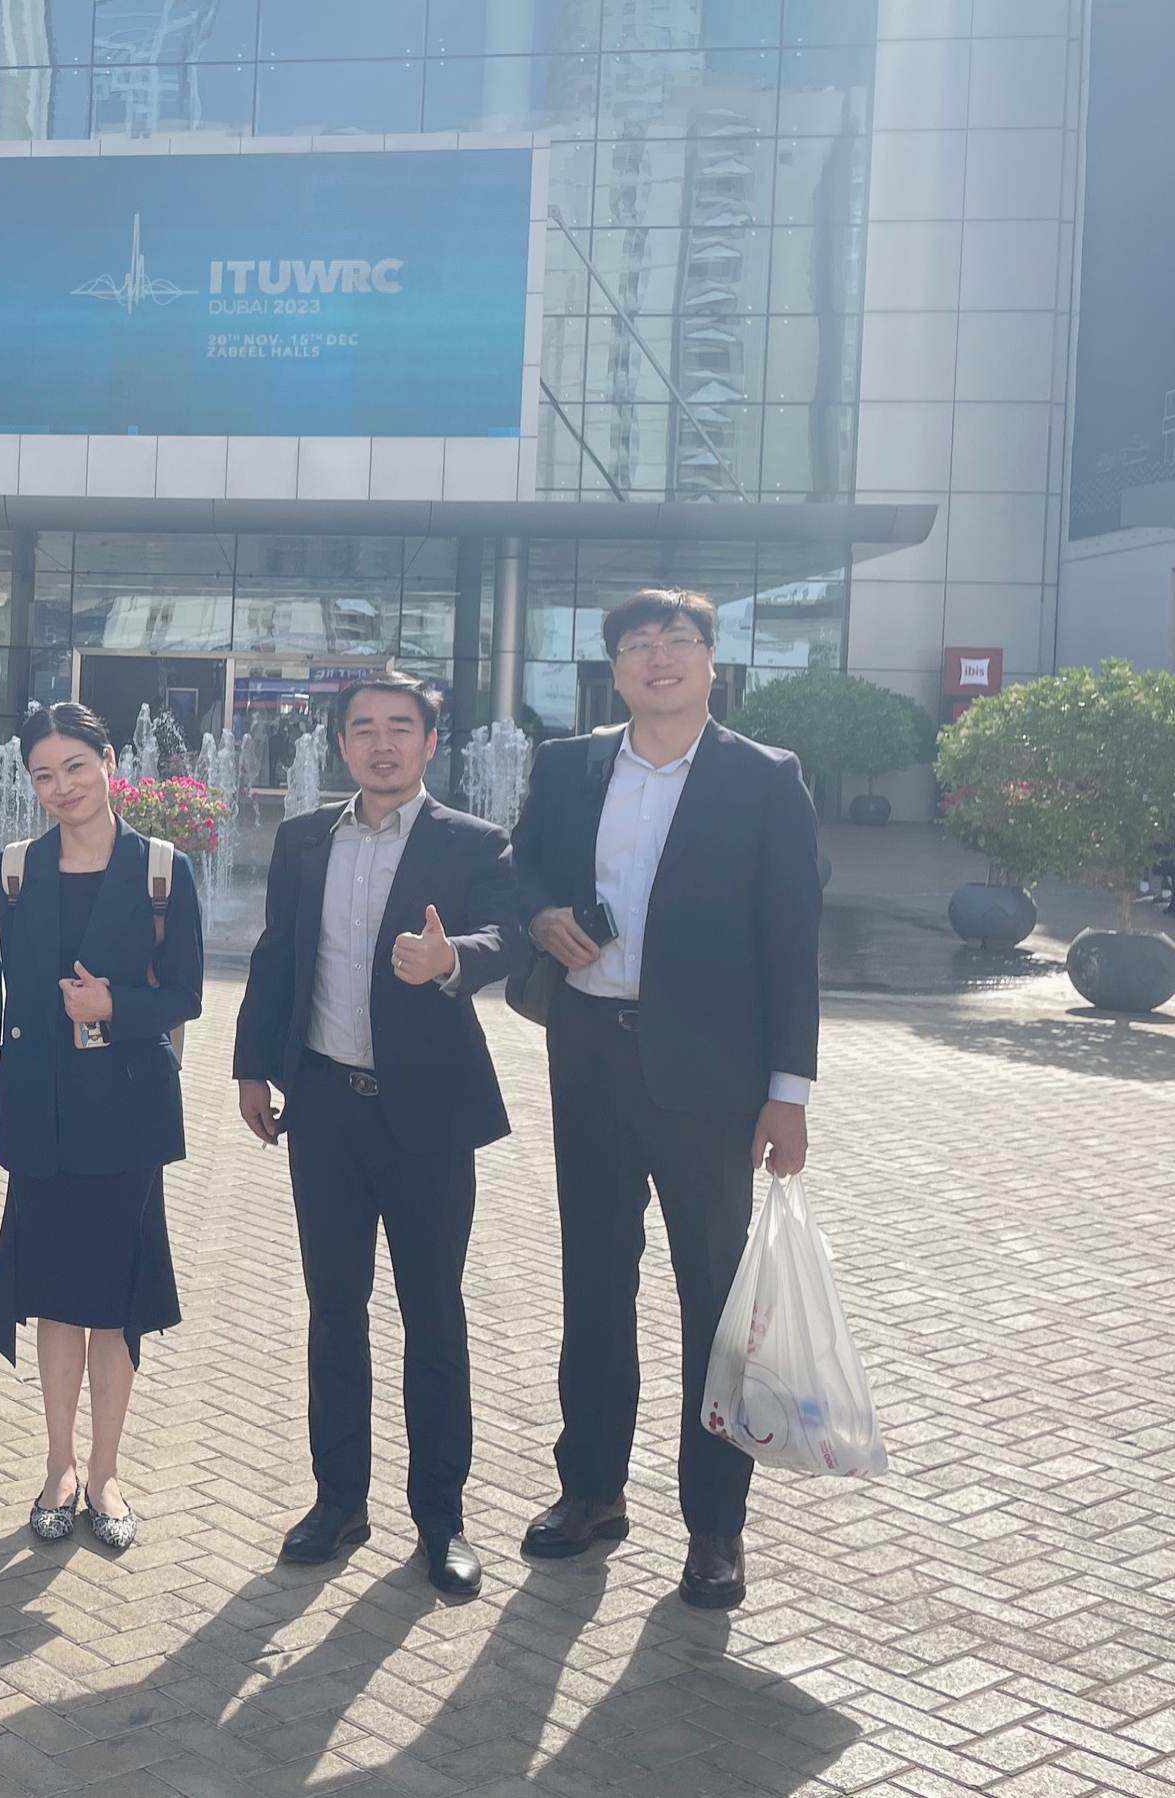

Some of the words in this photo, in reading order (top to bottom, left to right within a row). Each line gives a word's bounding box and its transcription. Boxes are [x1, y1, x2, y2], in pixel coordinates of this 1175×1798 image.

[209, 300, 268, 314] DUBAI
[274, 300, 320, 314] 2023
[326, 334, 358, 346] DEC
[207, 346, 266, 358] ZABEEL
[271, 346, 320, 358] HALLS
[965, 664, 985, 677] ibis
